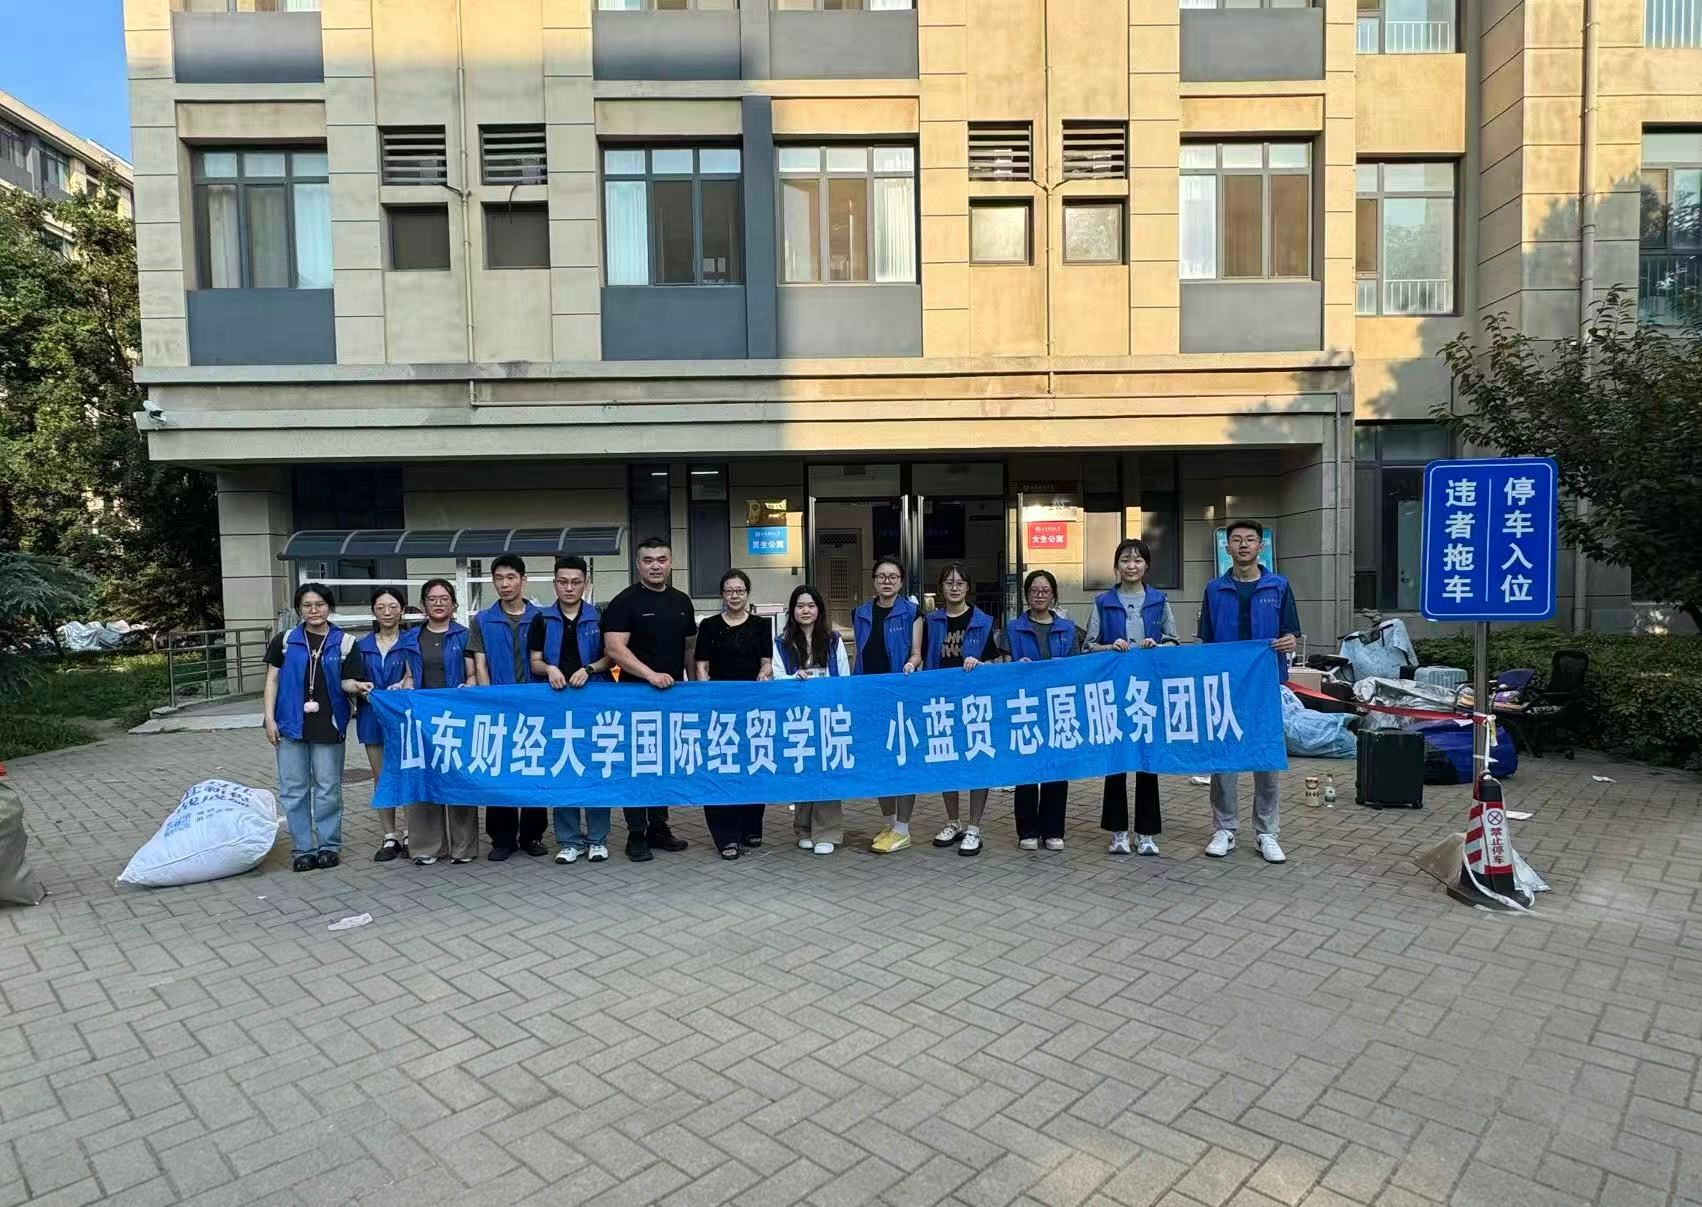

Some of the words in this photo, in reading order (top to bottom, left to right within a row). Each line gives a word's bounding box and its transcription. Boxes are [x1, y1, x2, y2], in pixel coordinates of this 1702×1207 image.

[1442, 478, 1476, 603] 违者拖车
[1500, 477, 1535, 603] 停车入位
[399, 703, 856, 778] 山东财经大学国际经贸学院
[1489, 827, 1505, 866] 禁止停车
